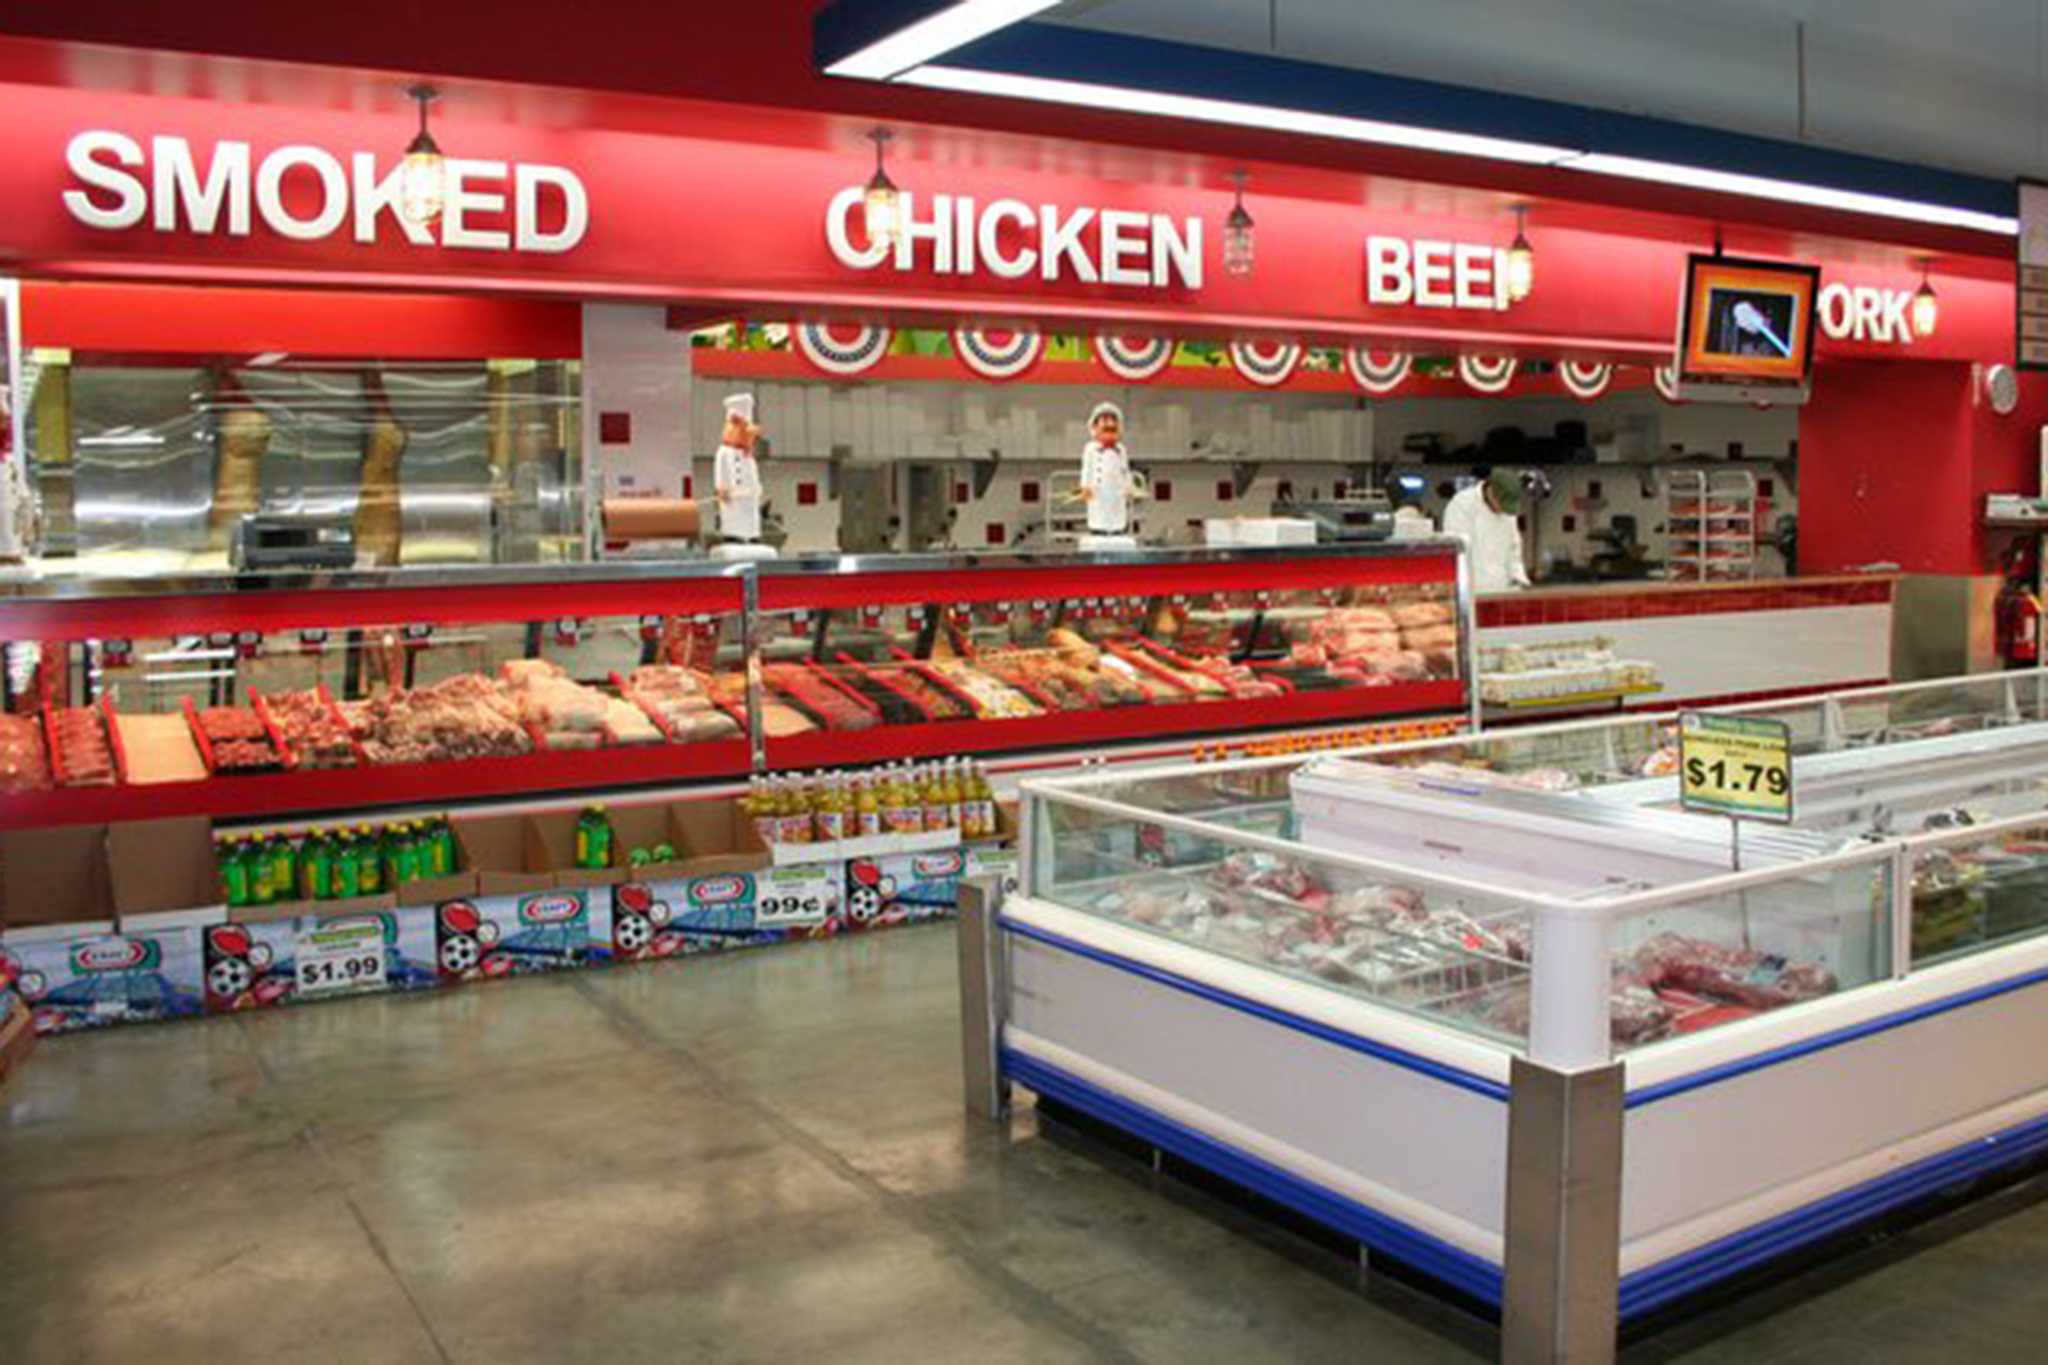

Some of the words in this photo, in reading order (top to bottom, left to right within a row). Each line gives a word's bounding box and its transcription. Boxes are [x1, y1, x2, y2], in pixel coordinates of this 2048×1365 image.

[62, 130, 590, 254] SMOKED
[826, 185, 1204, 290] CHICKEN
[1816, 282, 1914, 344] ORK
[1686, 757, 1790, 796] $1.79
[761, 895, 821, 916] 99¢
[301, 956, 380, 985] $1.99
